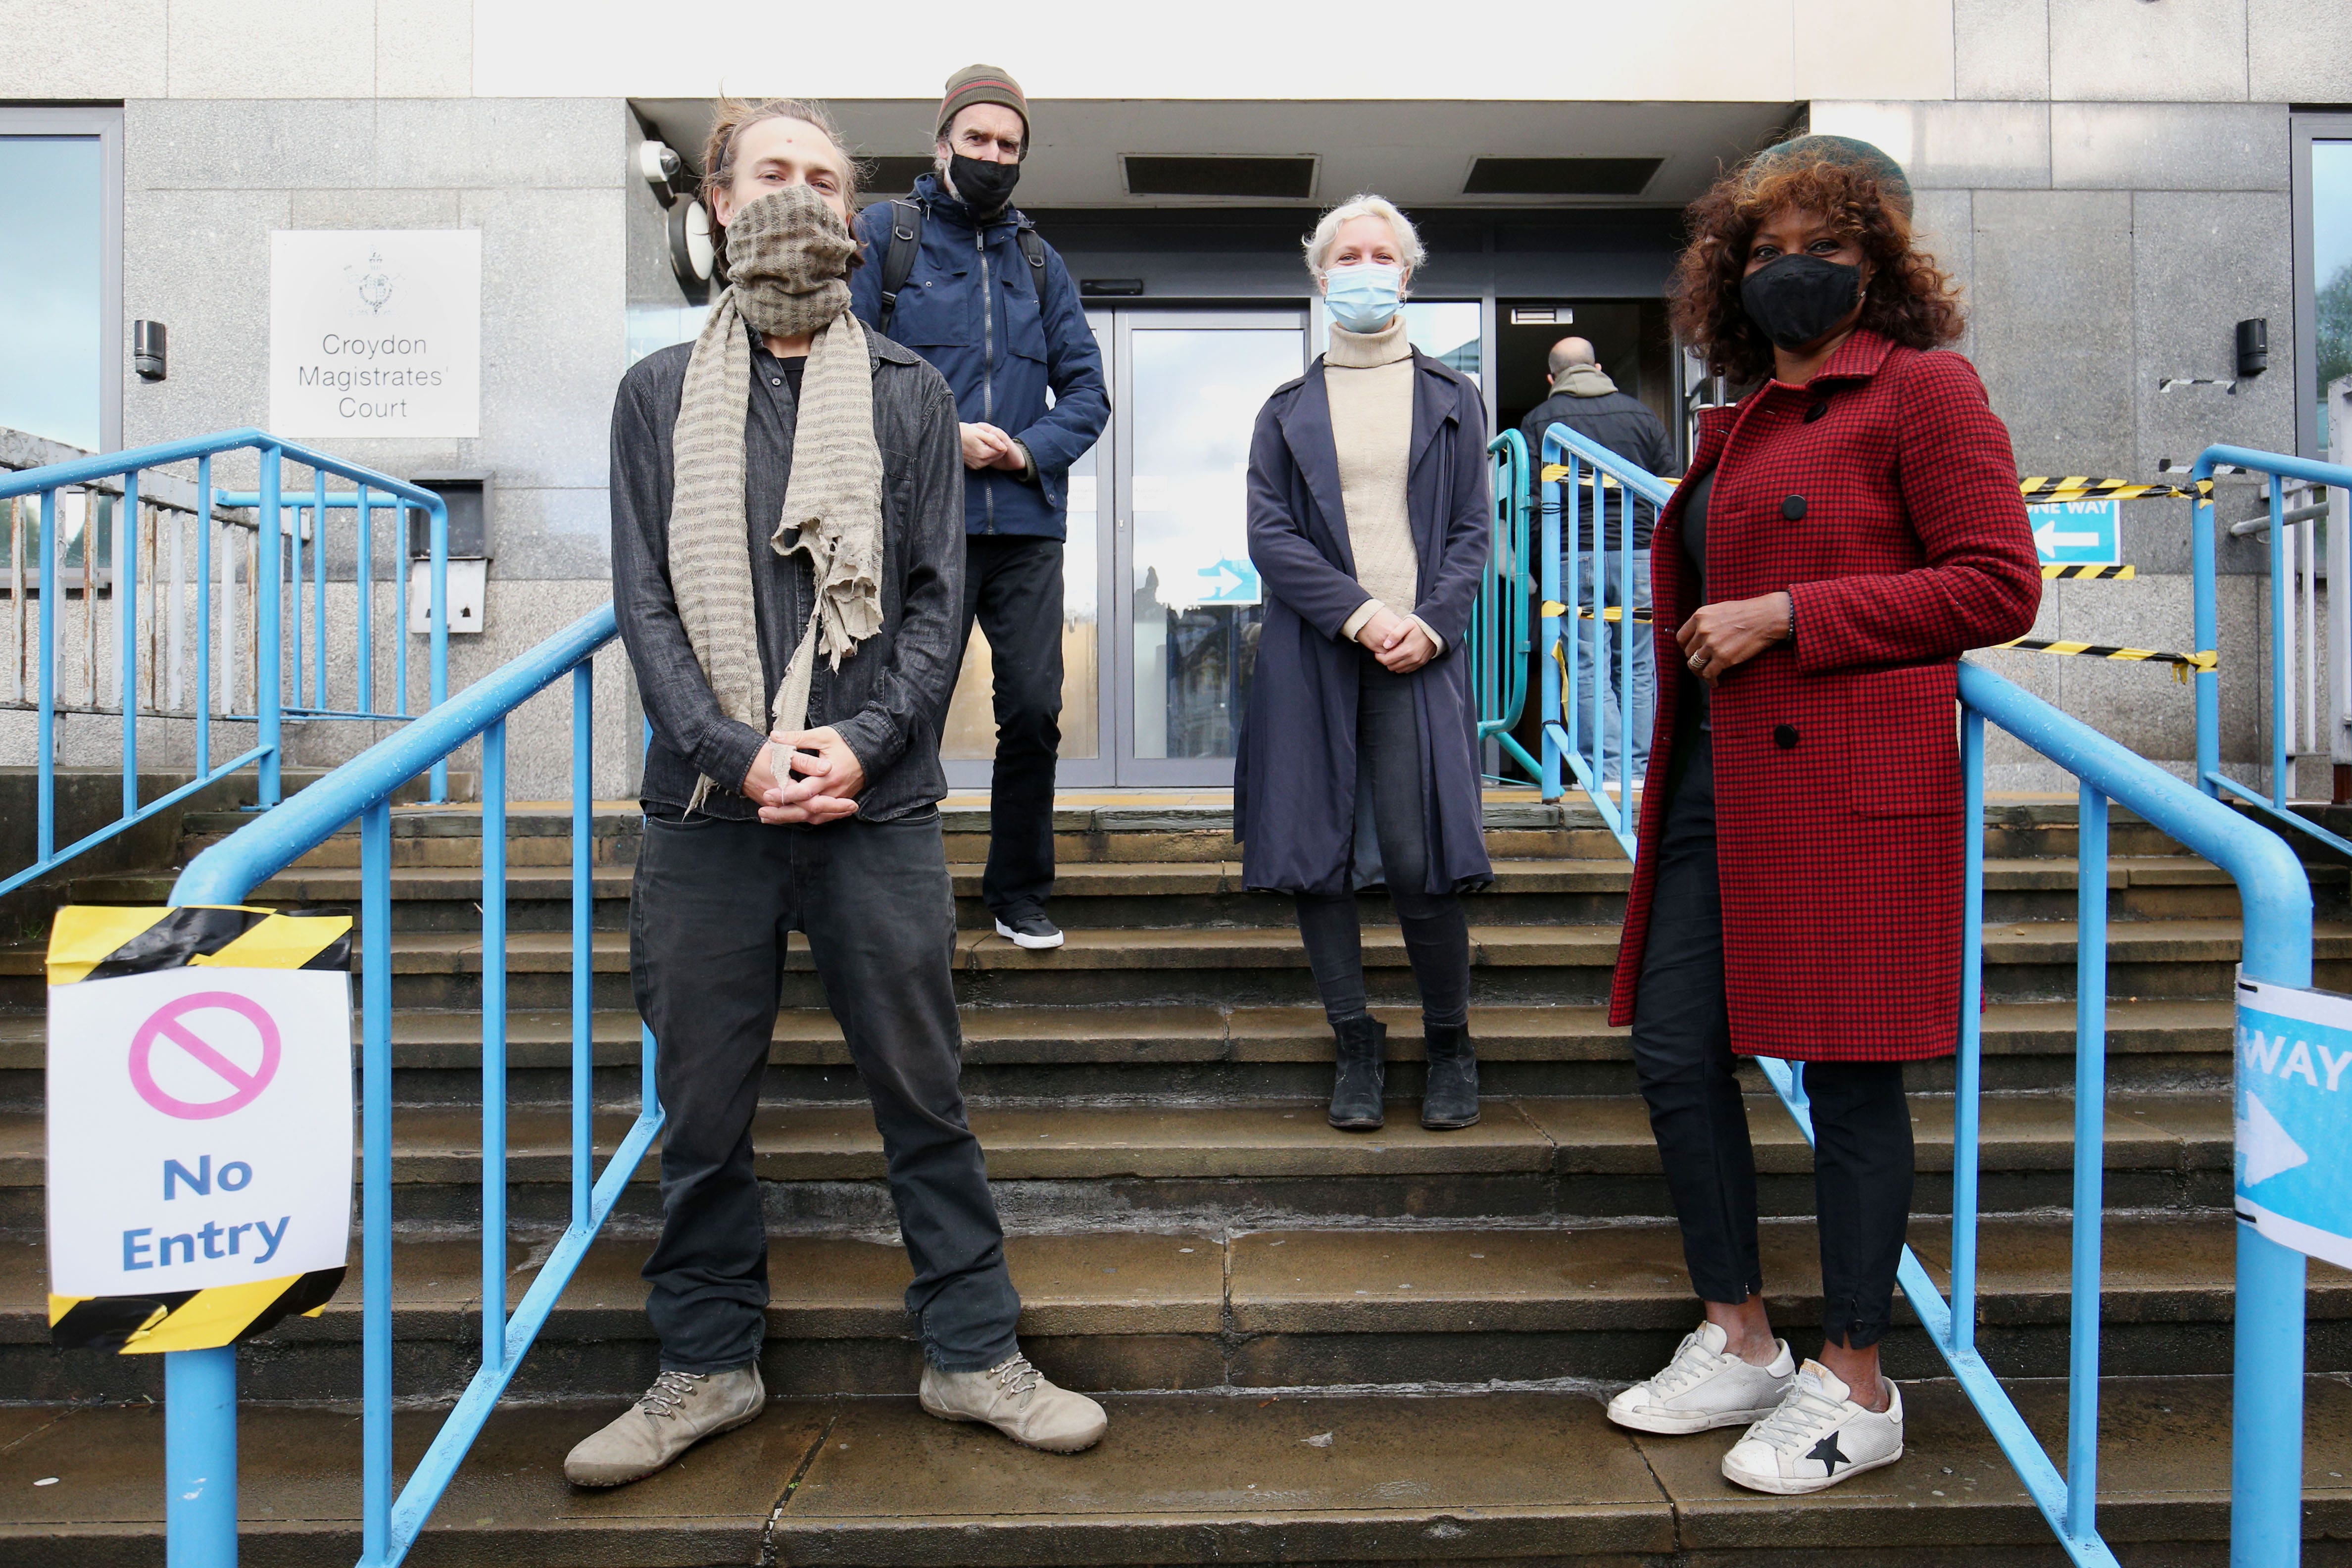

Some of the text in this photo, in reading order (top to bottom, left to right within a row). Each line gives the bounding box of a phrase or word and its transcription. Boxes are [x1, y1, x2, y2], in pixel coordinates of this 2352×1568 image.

[322, 334, 426, 360] Croydon
[299, 366, 448, 392] Magistrates'
[339, 397, 407, 418] Court
[2066, 500, 2110, 514] WAY
[2240, 1024, 2352, 1092] WAY
[164, 1155, 252, 1201] No
[123, 1216, 291, 1272] Entry
